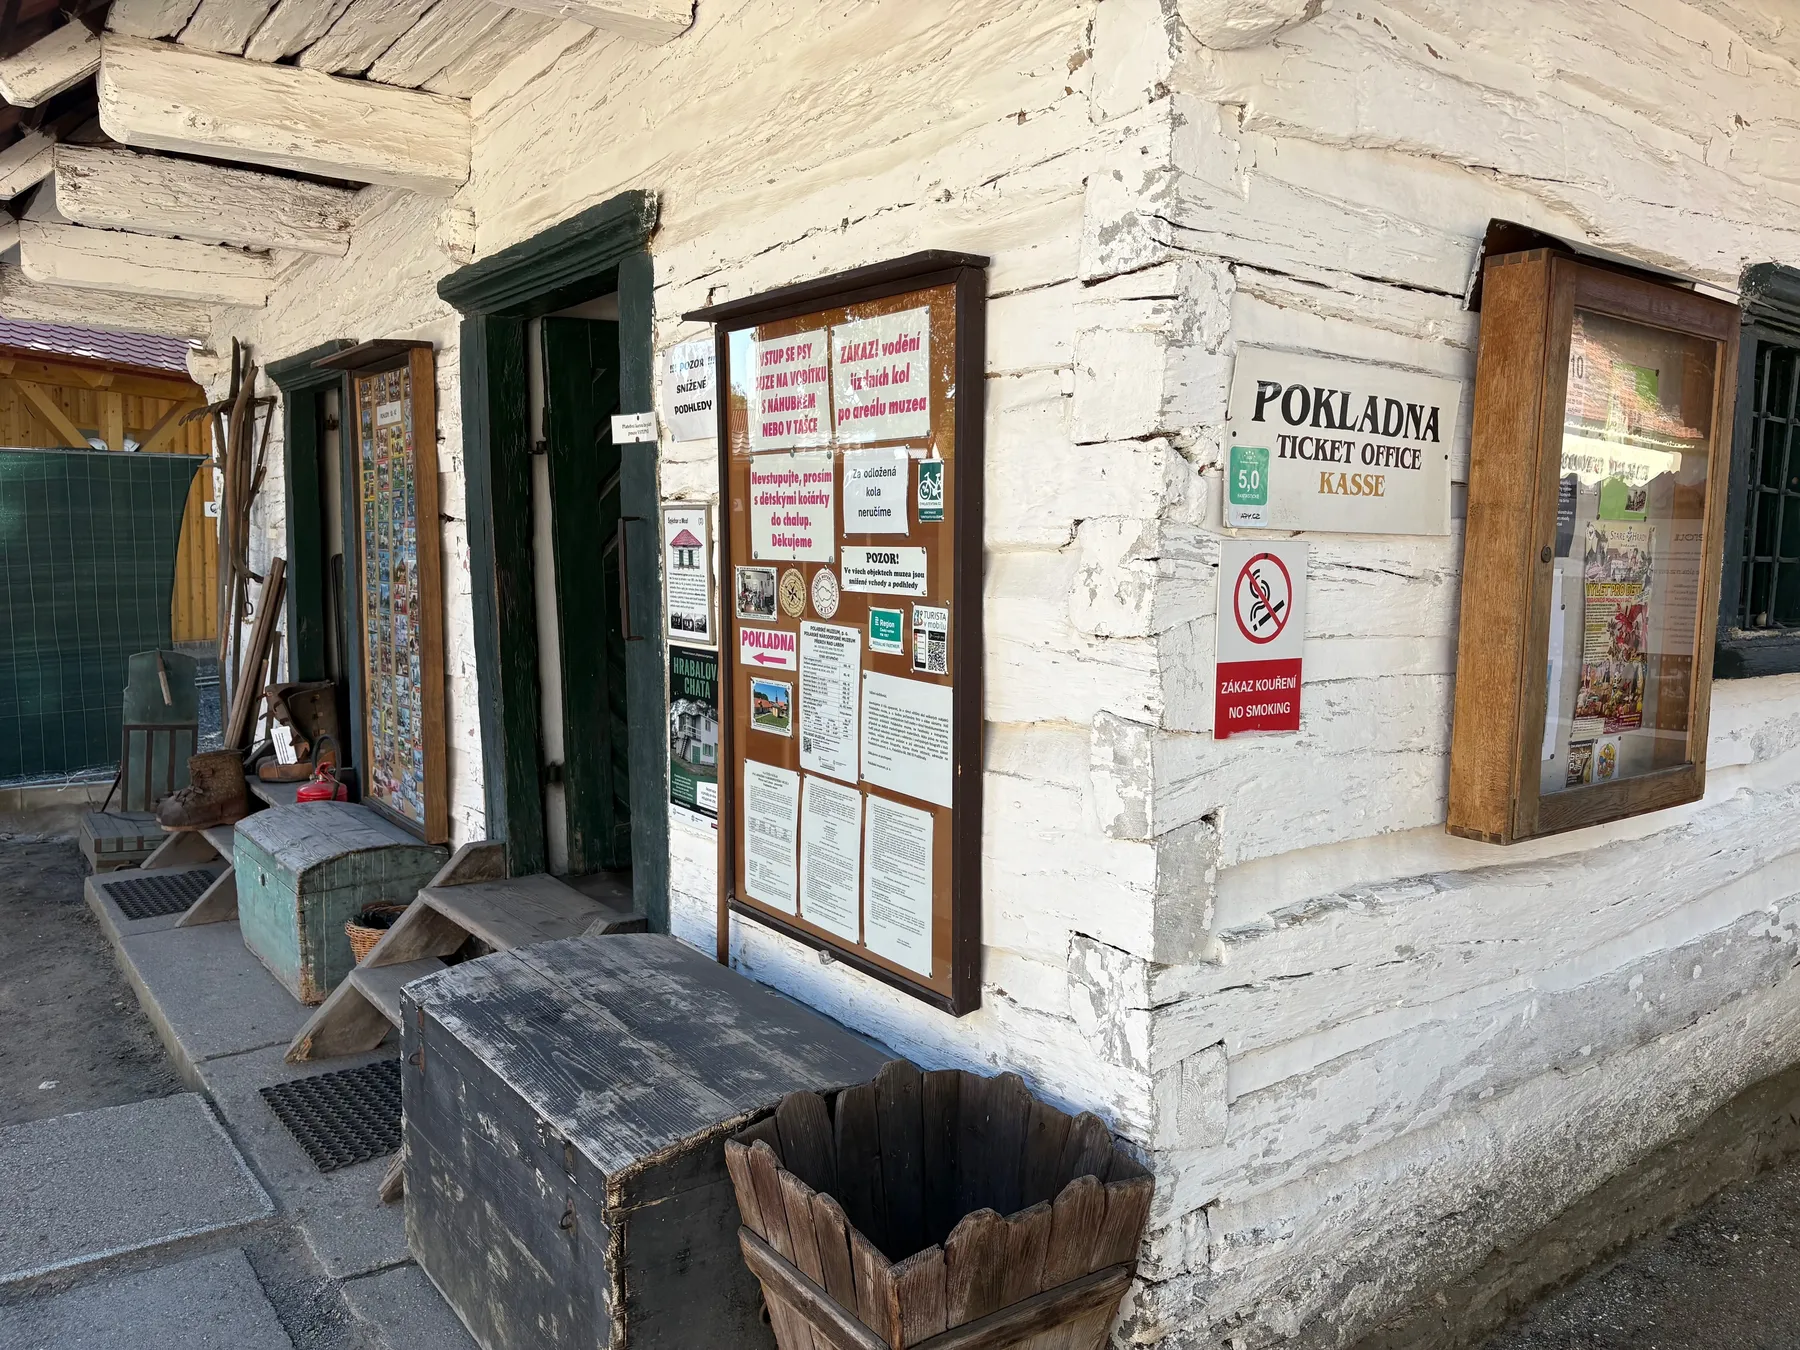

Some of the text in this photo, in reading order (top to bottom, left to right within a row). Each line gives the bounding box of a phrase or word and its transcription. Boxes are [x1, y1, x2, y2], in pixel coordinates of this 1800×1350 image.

[785, 346, 795, 363] SE
[797, 343, 812, 361] PSY
[840, 331, 921, 364] ZÁKAZ! vodění
[679, 358, 704, 371] POZOR
[676, 376, 706, 394] SNÍŽENÉ
[776, 372, 788, 388] NA
[790, 364, 827, 387] VODÍTKU
[850, 362, 910, 391] jízdních kol
[674, 400, 712, 415] PODHLEDY
[762, 393, 816, 414] S NÁHUBKEM
[838, 397, 927, 426] po areálu muzea
[1251, 380, 1441, 443] POKLADNA
[762, 414, 818, 437] NEBO V TAŠCE
[1276, 433, 1423, 471] TICKET OFFICE
[751, 468, 832, 487] Nevstupujte, prosím
[853, 466, 897, 479] Za odložená
[1238, 469, 1260, 492] 5,0
[866, 486, 881, 497] kola
[1317, 471, 1386, 498] KASSE
[754, 489, 830, 508] s dětskými kočárky
[771, 511, 812, 530] do chalup.
[858, 506, 892, 517] neručíme
[772, 533, 812, 551] Děkujeme
[866, 552, 900, 565] POZOR!
[852, 567, 867, 575] všech
[867, 569, 892, 577] objektech
[912, 571, 925, 579] jsou
[868, 578, 887, 588] vchody
[893, 580, 918, 590] podhledy
[1612, 583, 1625, 597] PRO
[880, 619, 895, 629] Region
[924, 610, 946, 621] TURISTA
[928, 621, 946, 631] mobilu
[742, 629, 795, 652] POKLADNA
[684, 677, 711, 699] CHATA
[1221, 674, 1297, 695] ZÁKAZ KOUŘENÍ
[1229, 701, 1291, 719] NO SMOKING
